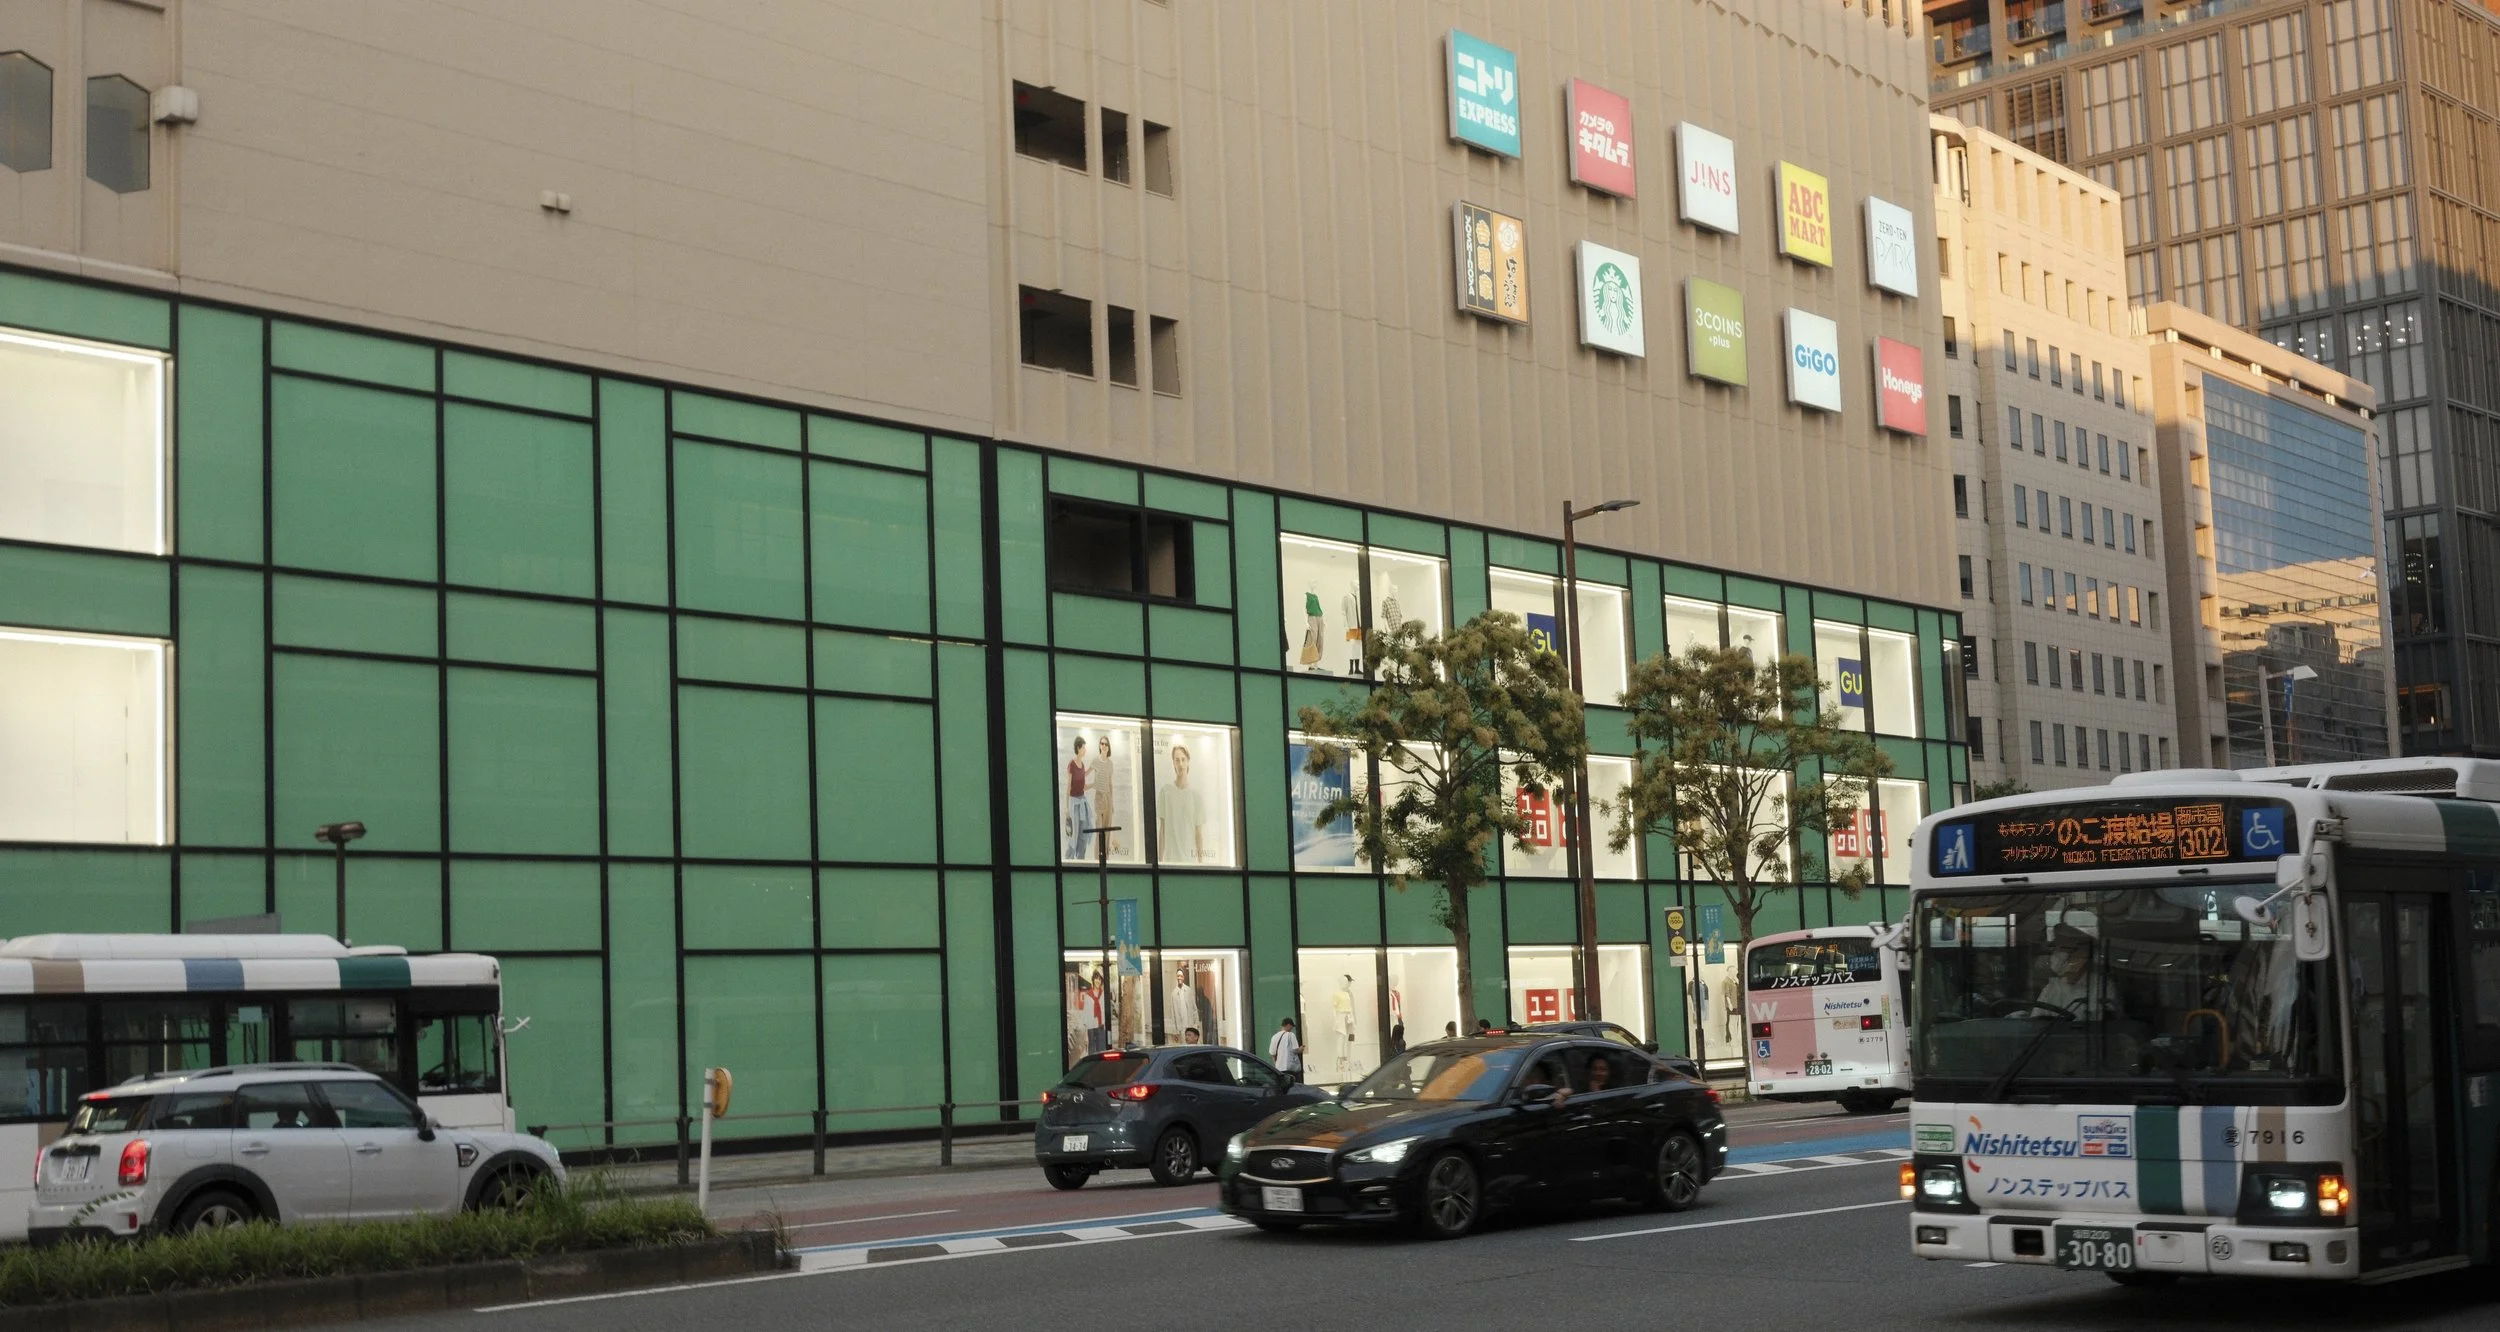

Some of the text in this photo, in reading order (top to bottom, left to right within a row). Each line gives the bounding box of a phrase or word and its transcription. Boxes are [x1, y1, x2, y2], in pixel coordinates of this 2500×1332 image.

[1457, 51, 1515, 106] ニトリ
[1458, 96, 1517, 137] EXPRESS
[1578, 110, 1615, 136] カメラの
[1578, 127, 1630, 168] キタムラ
[1788, 180, 1824, 224] ABC
[1789, 215, 1826, 249] MART
[1874, 236, 1914, 274] PARK
[1694, 307, 1743, 339] 3COINS
[1794, 343, 1837, 377] GiGO
[1881, 366, 1923, 405] Honeys
[1840, 670, 1864, 695] GU
[1291, 780, 1343, 801] AIRism
[1837, 834, 1857, 851] クロ
[2057, 812, 2176, 846] のこ渡船場
[2180, 825, 2226, 857] 302
[2101, 845, 2175, 863] FERRYPORT
[1770, 971, 1855, 989] ノンステップバス
[1752, 1001, 1778, 1021] W
[1824, 999, 1863, 1011] Nishitetsu
[1965, 1131, 2078, 1157] Nishitetsu
[2249, 1130, 2306, 1145] 7916
[1987, 1177, 2131, 1198] ノンステップバス
[2068, 1239, 2132, 1268] 30-80
[2212, 1239, 2230, 1255] 60
